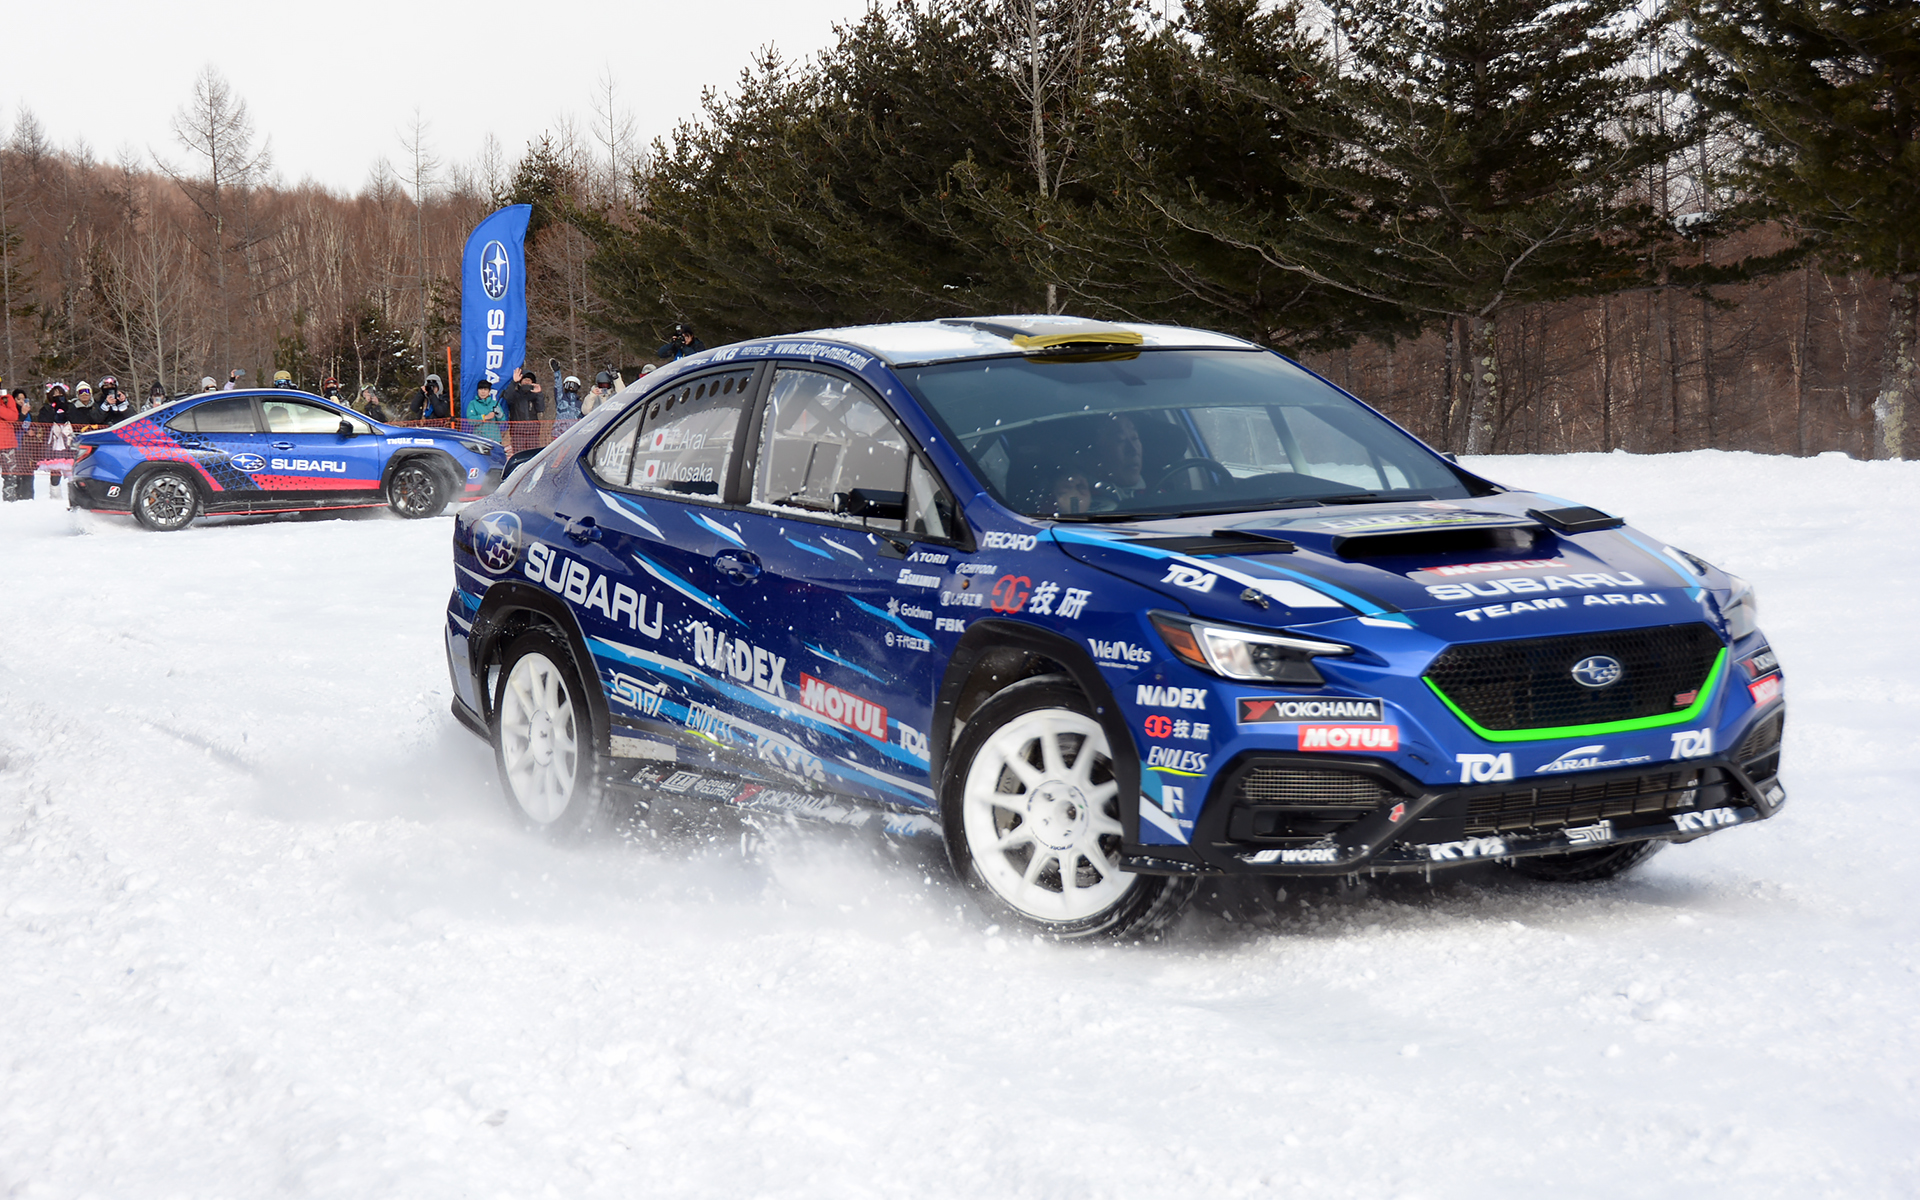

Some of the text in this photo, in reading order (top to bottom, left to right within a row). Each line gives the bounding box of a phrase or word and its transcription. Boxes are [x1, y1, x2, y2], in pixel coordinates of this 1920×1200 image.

[485, 309, 505, 401] SUBA
[711, 346, 739, 362] NKB
[270, 458, 347, 473] SUBARU
[660, 462, 714, 483] N.Kosaka
[982, 531, 1037, 551] RECARO
[523, 541, 663, 640] SUBARU
[1424, 571, 1645, 601] SUBARU
[900, 603, 933, 620] Goldwin
[1029, 580, 1092, 620] 技研
[1455, 593, 1667, 622] TEAM ARAI
[935, 617, 967, 633] FBK
[691, 619, 787, 699] NADEX
[802, 678, 885, 739] MOTUL
[1136, 684, 1208, 710] NADEX
[1274, 702, 1378, 718] YOKOHAMA
[684, 702, 739, 745] ENDLESS
[1172, 718, 1210, 741] 技研
[1303, 728, 1395, 748] MOTUL
[1147, 745, 1209, 773] ENDLESS
[1671, 807, 1739, 831] KYB
[1281, 848, 1338, 863] WORK
[1426, 837, 1506, 861] KYB
